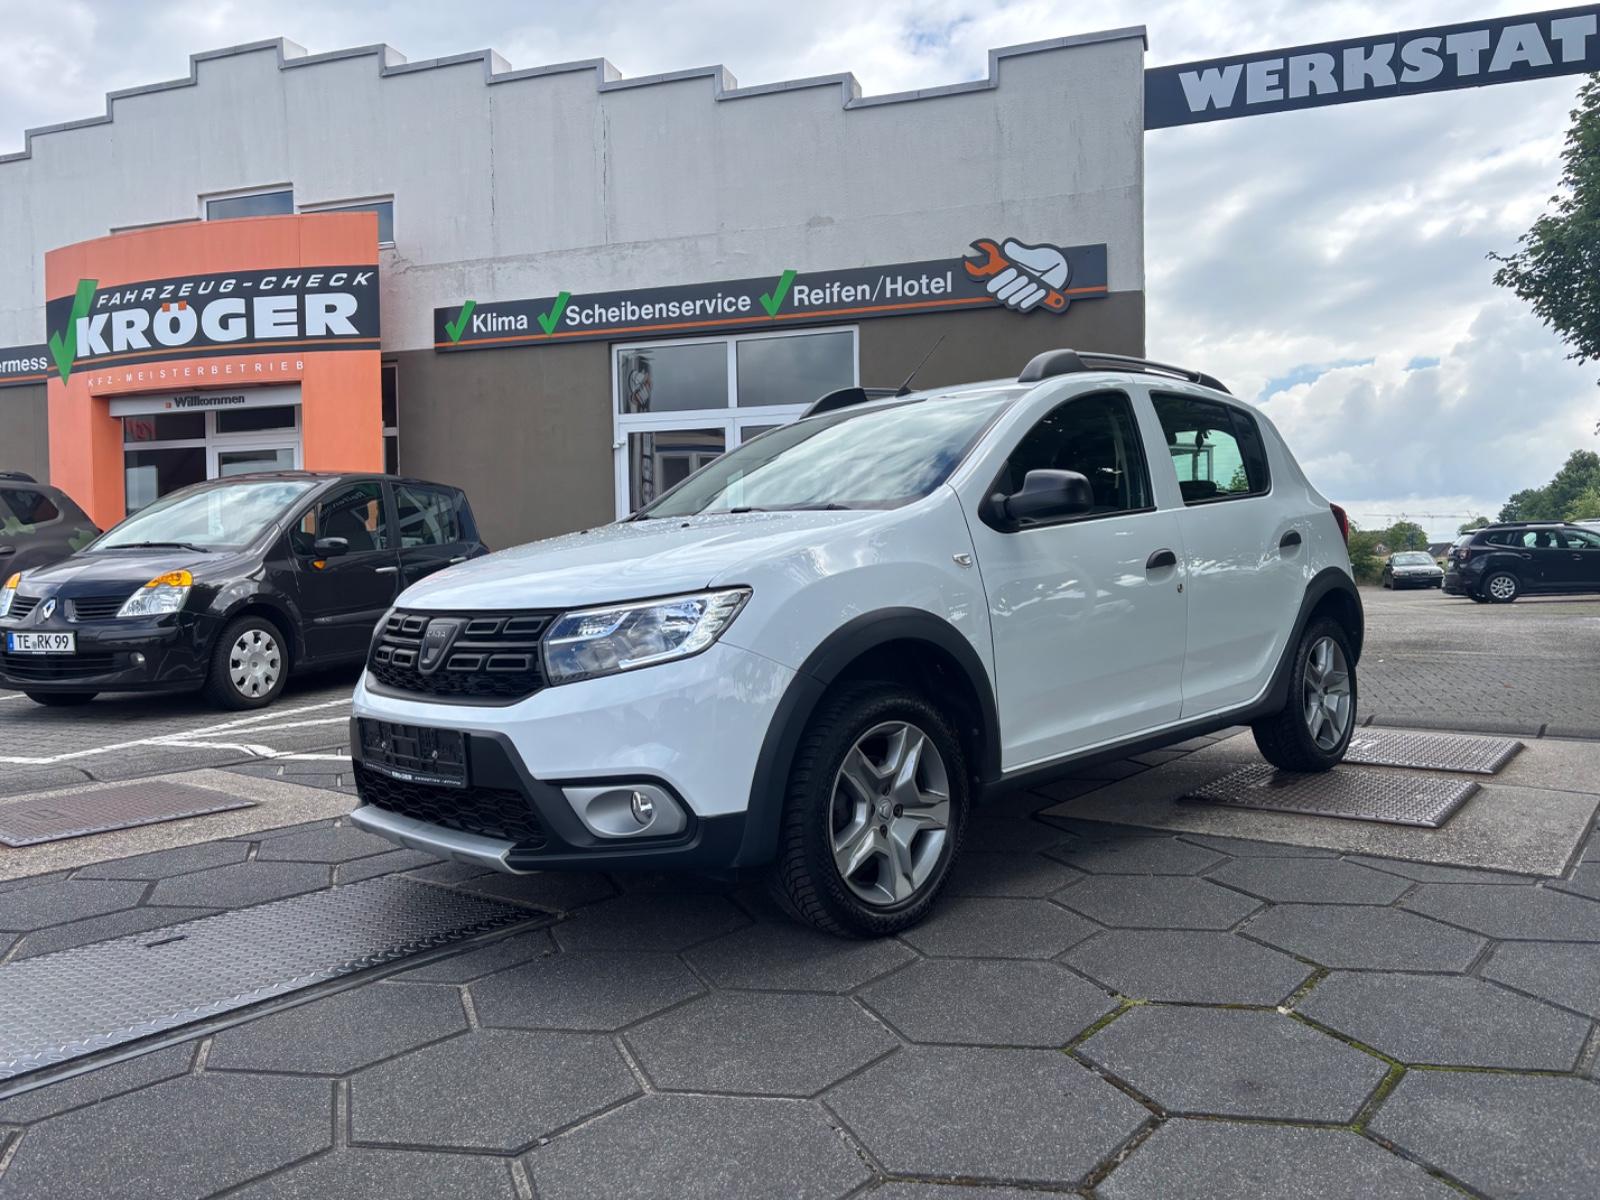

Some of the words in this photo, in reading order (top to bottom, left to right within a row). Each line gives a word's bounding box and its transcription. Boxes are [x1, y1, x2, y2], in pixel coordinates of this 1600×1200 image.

[1178, 14, 1597, 112] WERKSTAT
[96, 271, 374, 309] FAHRZEUG-CHECK
[472, 313, 528, 333] Klima
[565, 293, 751, 326] Scheibenservice
[793, 271, 952, 307] Reifen/Hotel
[76, 292, 360, 350] KRÖGER
[0, 357, 48, 373] rmess
[88, 360, 305, 387] KFZ-MEISTERBETRIEB
[174, 394, 245, 408] Willkommen
[17, 634, 30, 649] TE
[37, 634, 52, 649] RK
[55, 634, 69, 649] 99
